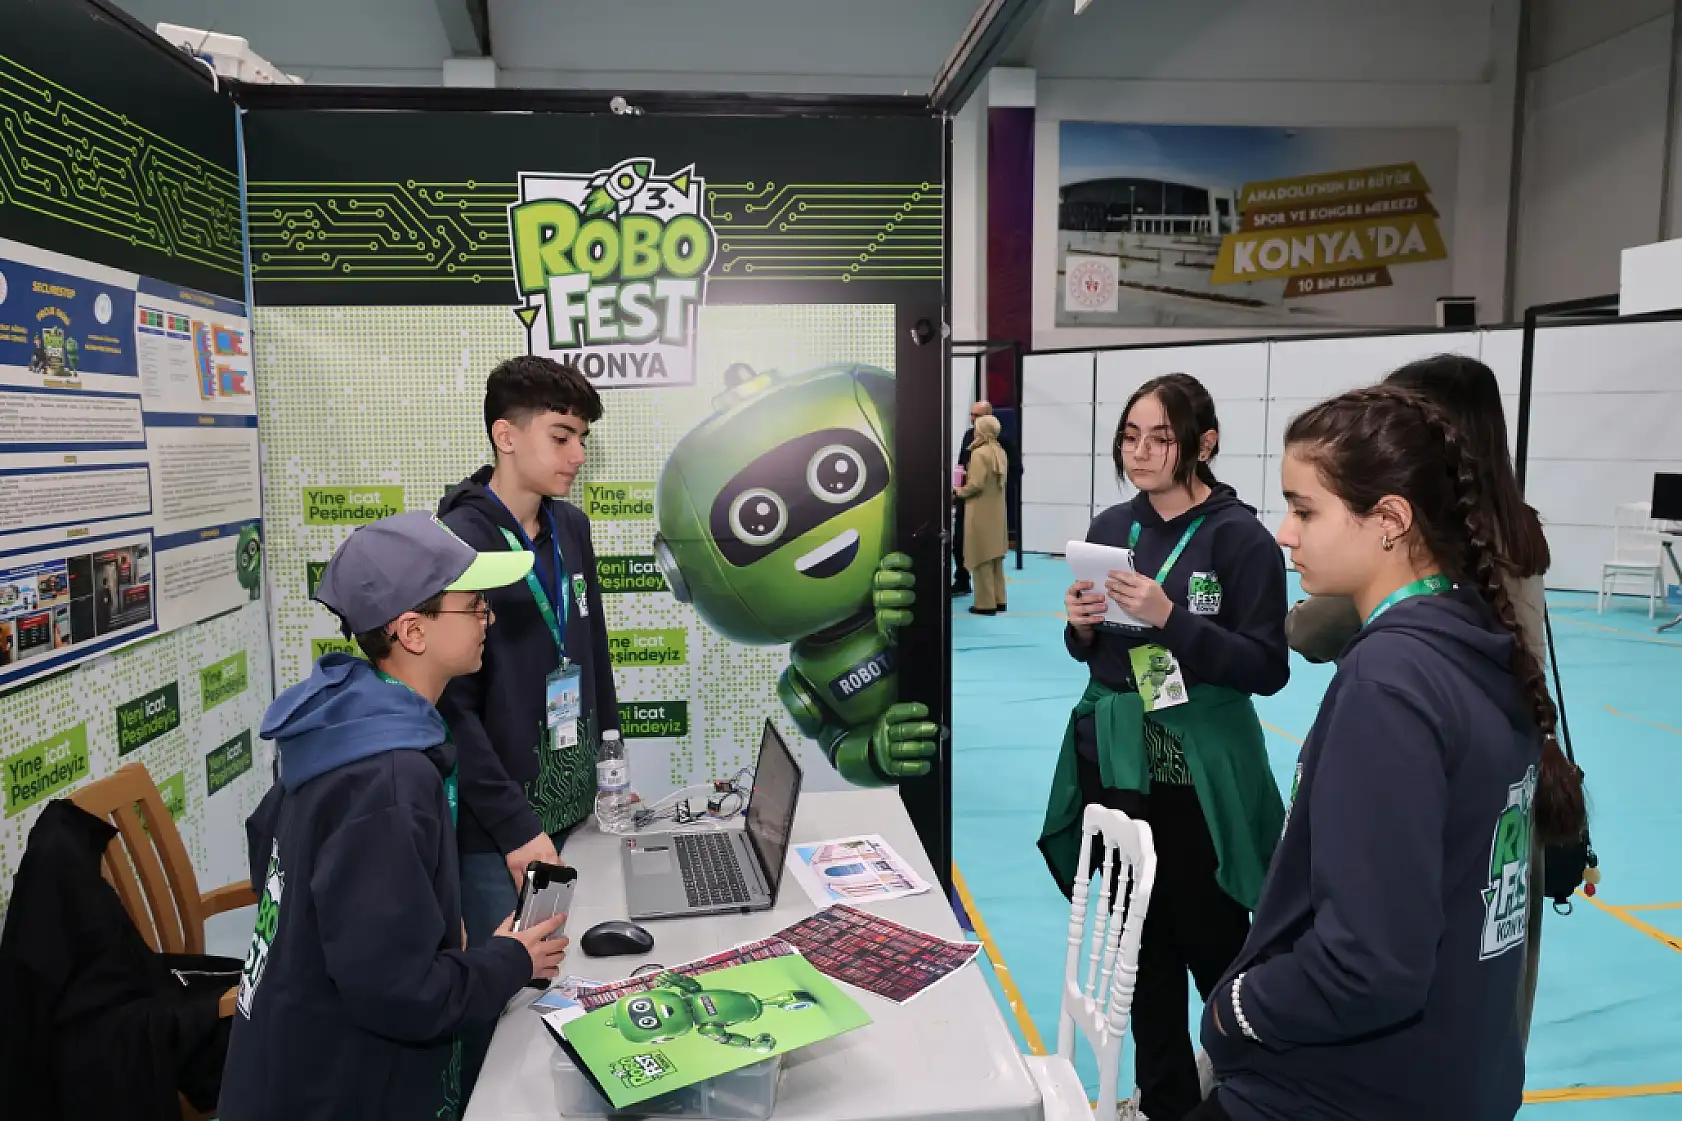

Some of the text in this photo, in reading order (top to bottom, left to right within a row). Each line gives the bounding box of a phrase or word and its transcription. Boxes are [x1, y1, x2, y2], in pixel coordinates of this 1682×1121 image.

[645, 187, 676, 211] 3.
[1253, 210, 1286, 227] SPOR
[512, 198, 711, 291] ROBO
[1233, 222, 1428, 274] KONYA'DA
[547, 272, 701, 346] FEST
[563, 352, 668, 379] KONYA
[308, 489, 381, 504] Yine icat
[589, 485, 653, 501] Yine ica
[589, 500, 654, 517] Peşinde
[608, 633, 665, 648] ne icat
[838, 653, 889, 696] ROBOT
[633, 705, 665, 720] icat
[8, 756, 43, 782] Yine
[11, 752, 86, 807] Peşindeyiz
